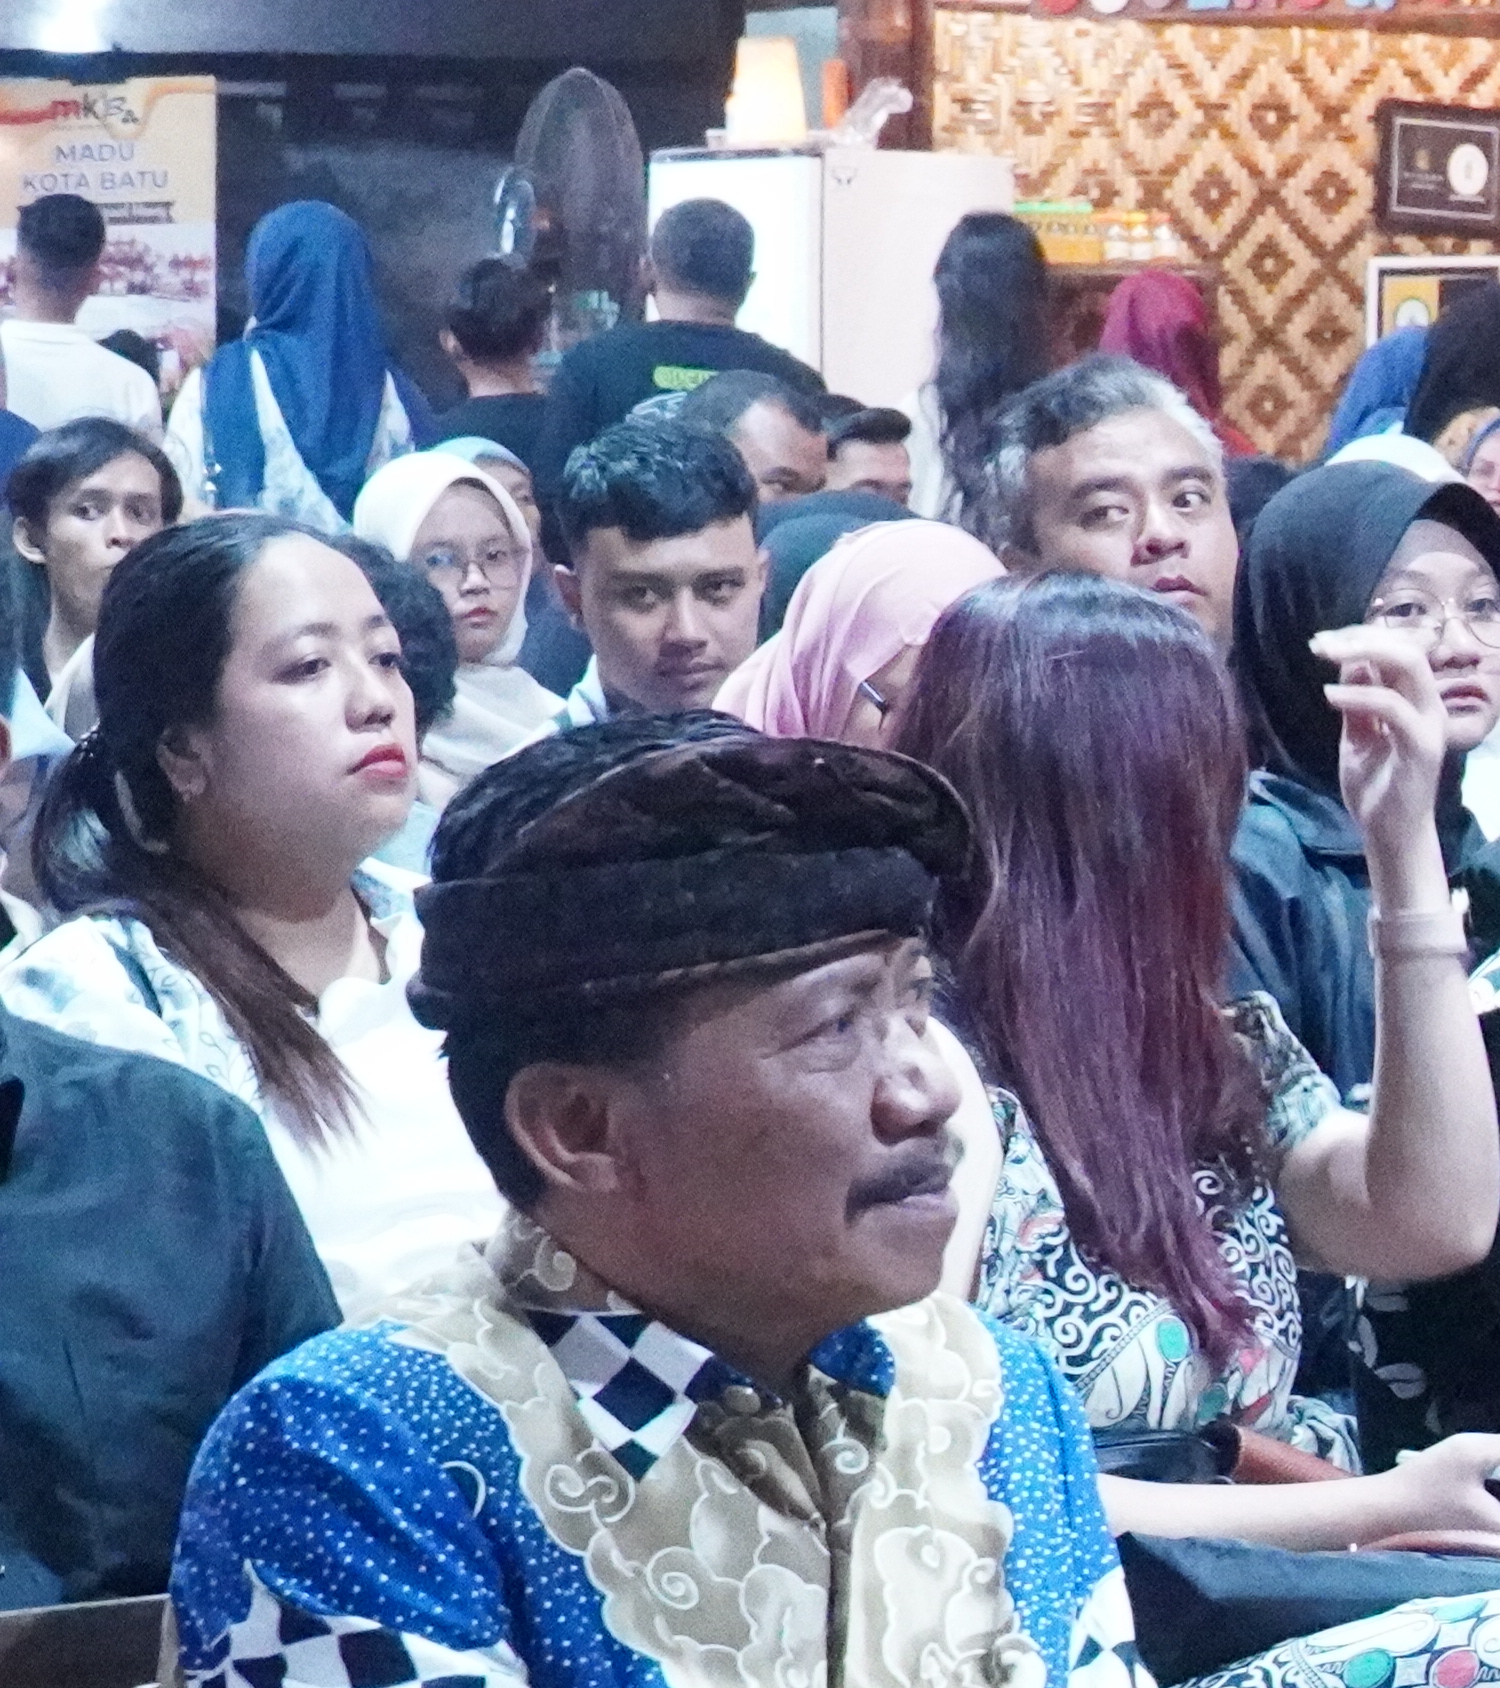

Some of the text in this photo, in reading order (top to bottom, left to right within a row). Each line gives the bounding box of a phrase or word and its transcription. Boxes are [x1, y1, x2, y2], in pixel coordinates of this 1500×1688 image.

[55, 143, 134, 162] MADU
[23, 170, 168, 191] KOTA BATU
